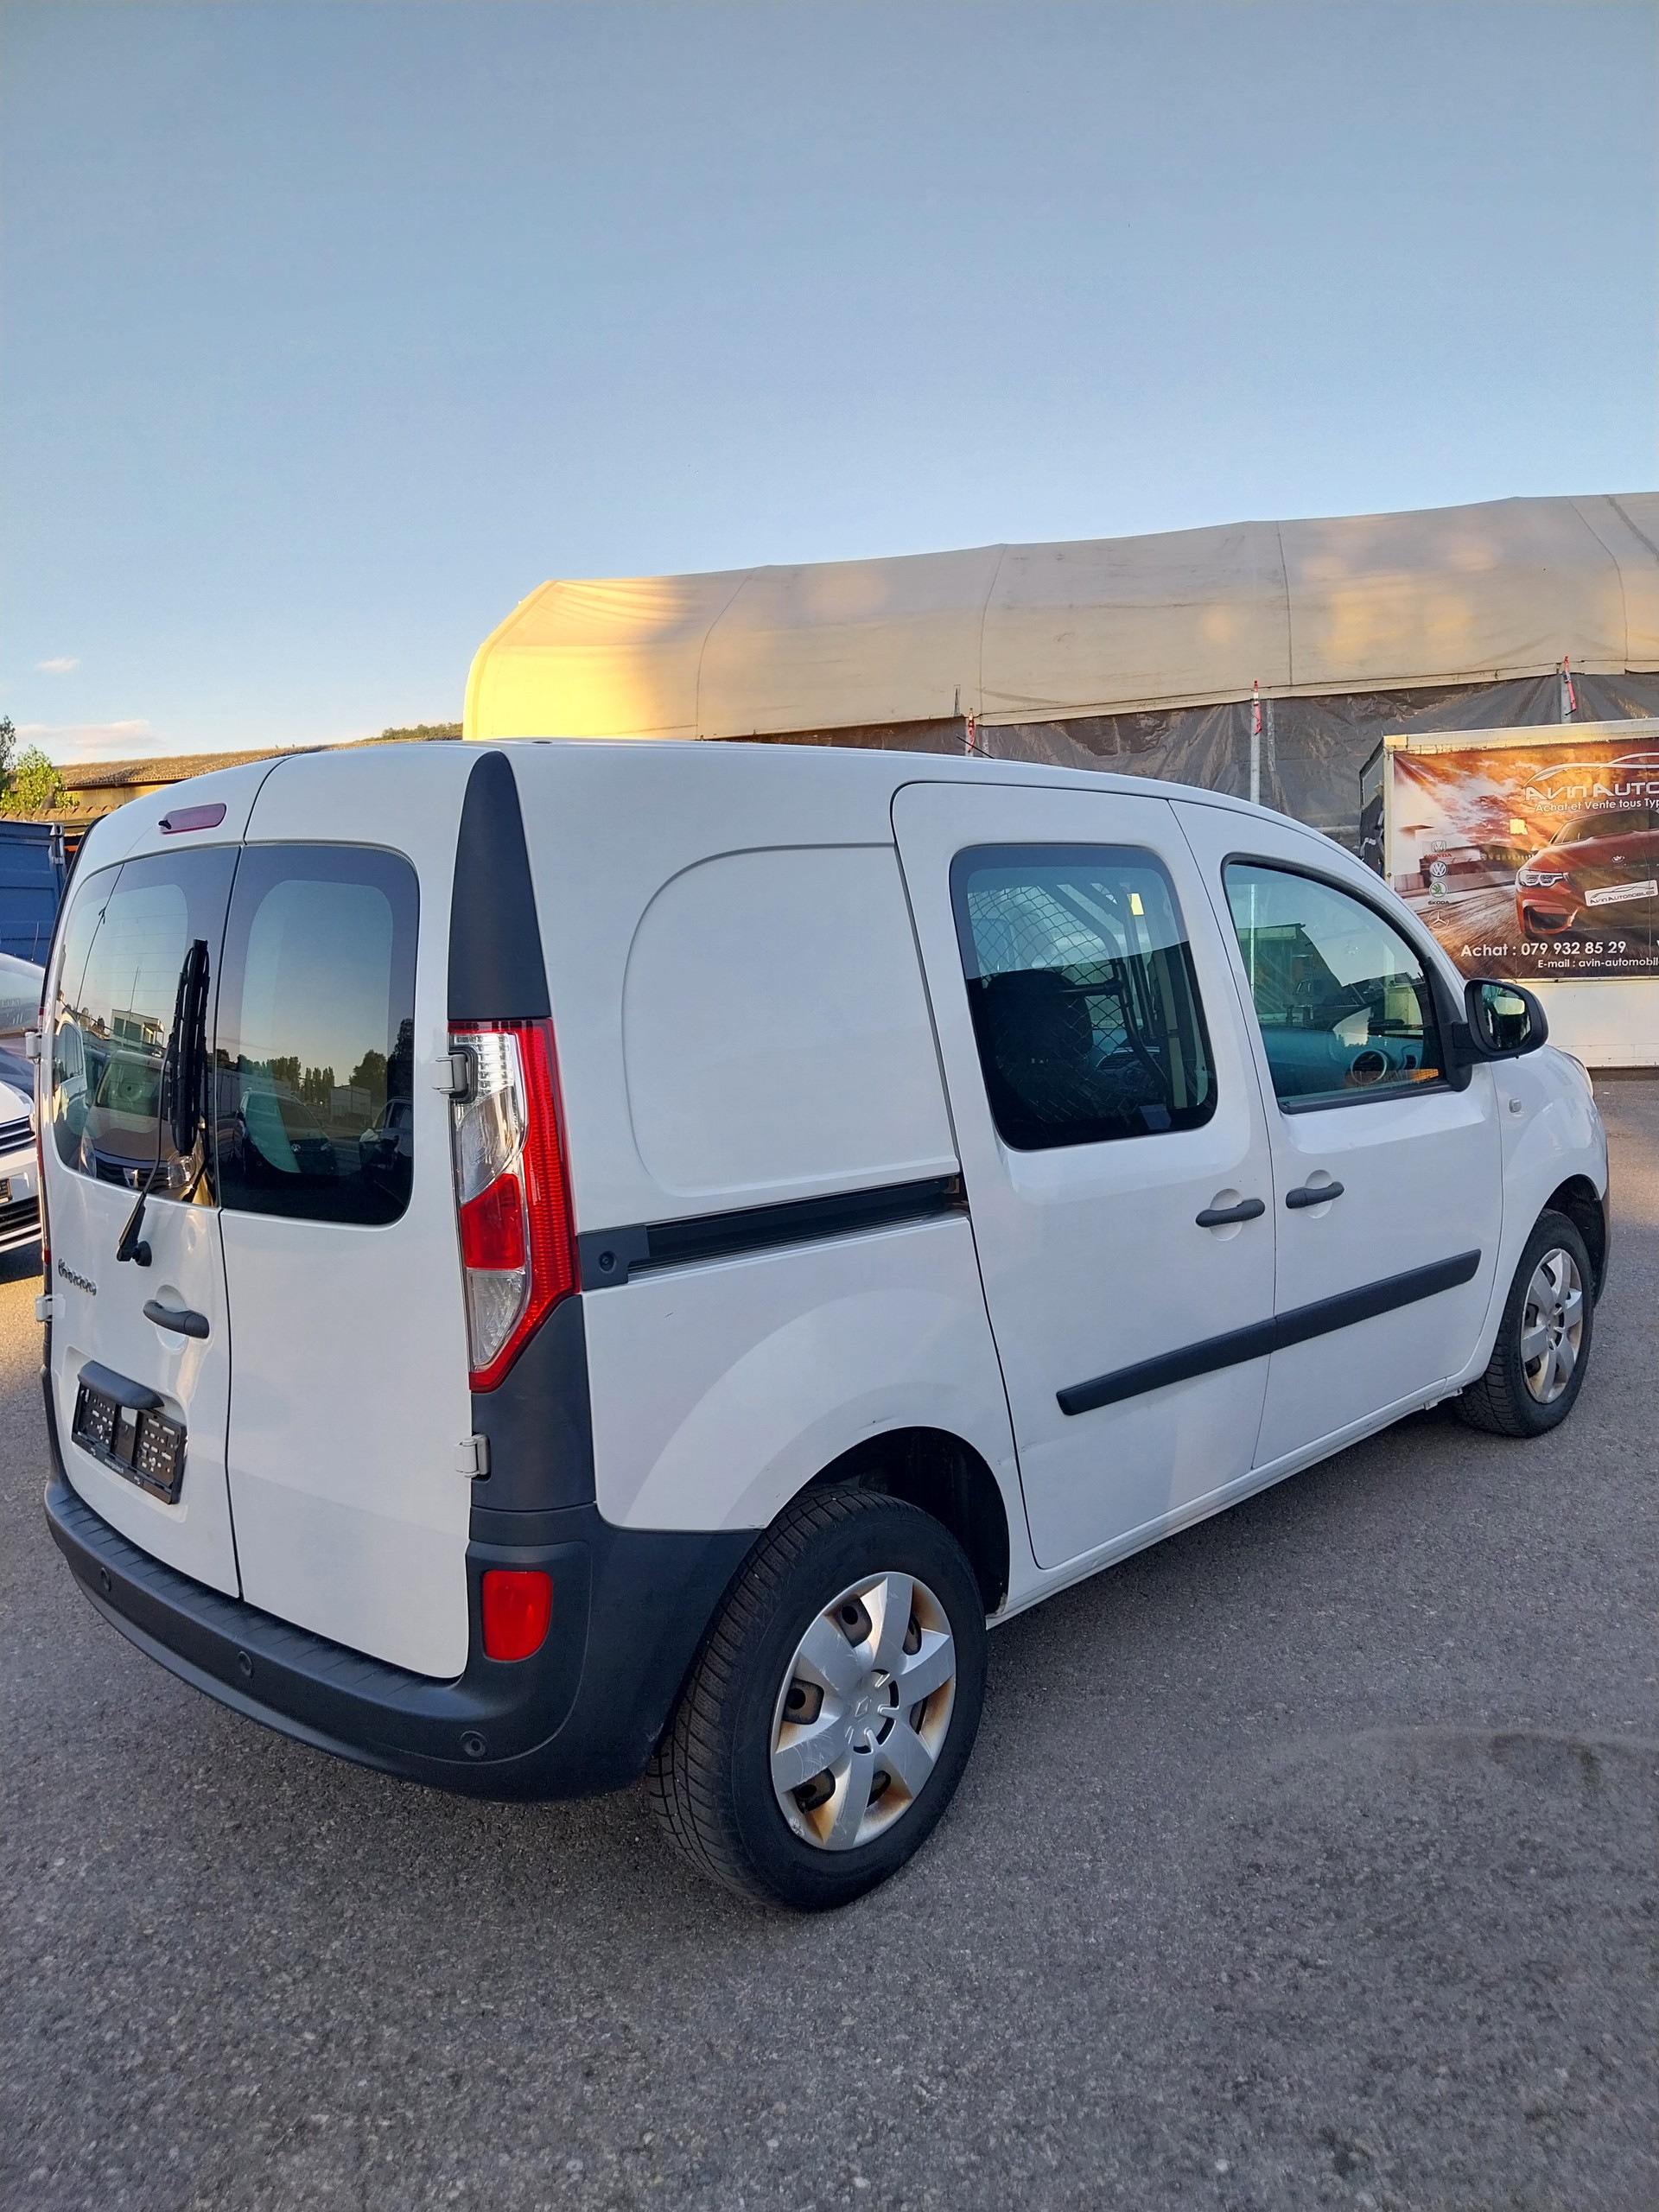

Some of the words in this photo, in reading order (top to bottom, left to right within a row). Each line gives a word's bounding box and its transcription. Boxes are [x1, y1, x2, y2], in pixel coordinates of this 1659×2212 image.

[1535, 803, 1568, 812] Achat
[1571, 802, 1581, 810] et
[1585, 799, 1616, 810] Vente
[1619, 798, 1642, 808] tous
[1461, 943, 1509, 957] Achat
[1521, 943, 1548, 956] 079
[1554, 942, 1580, 955] 932
[1585, 942, 1604, 954] 85
[1607, 941, 1626, 954] 29
[1538, 959, 1570, 968] E-mail
